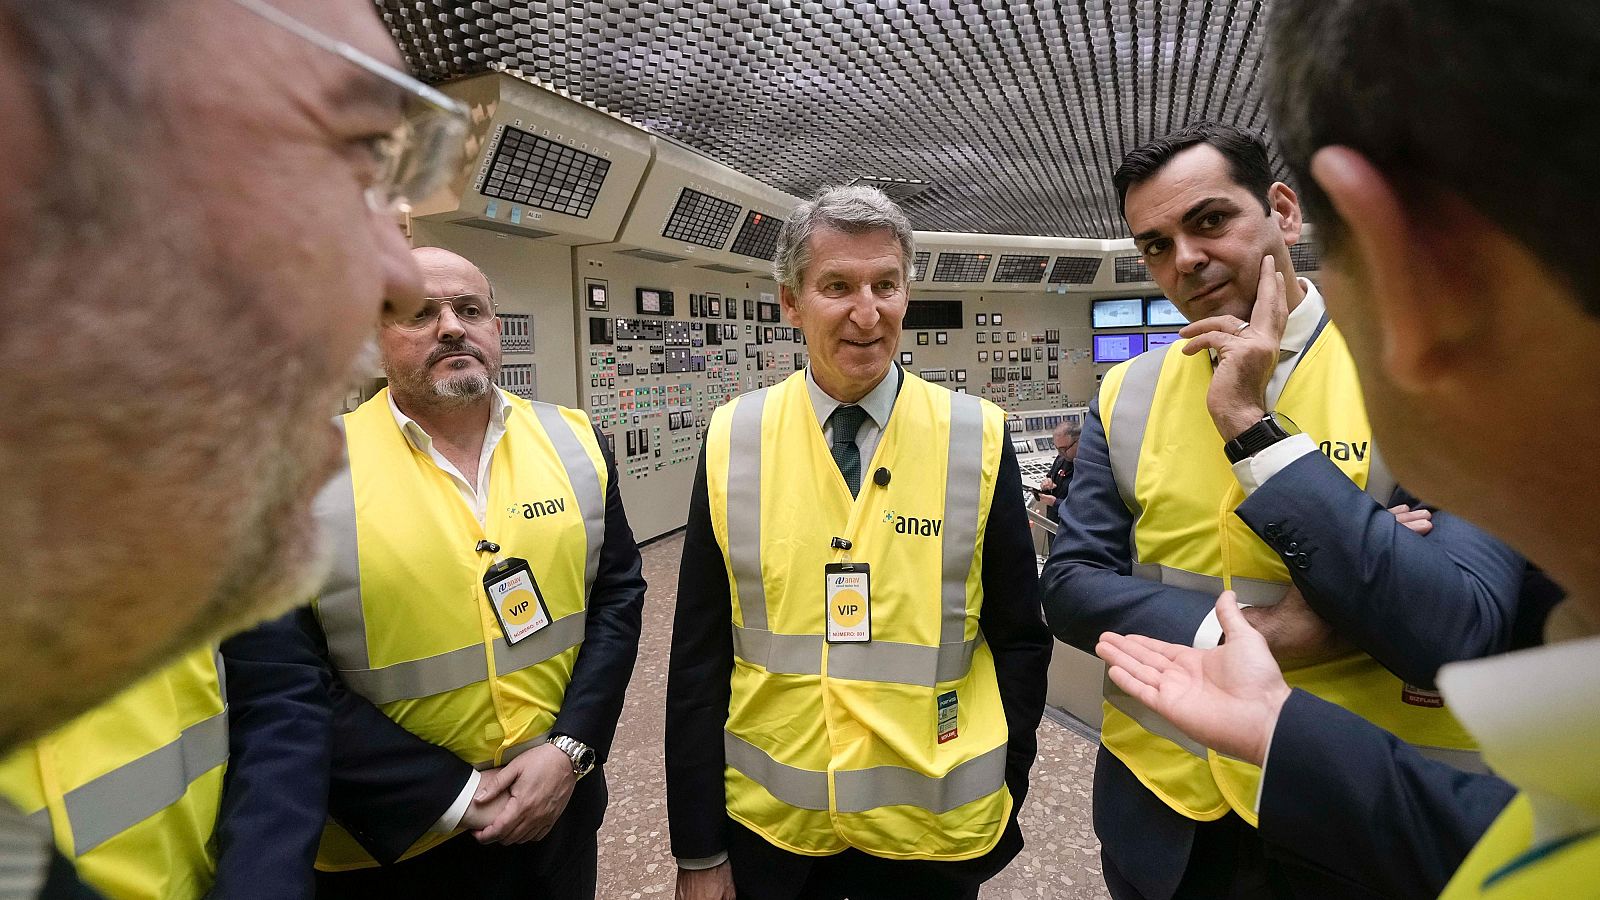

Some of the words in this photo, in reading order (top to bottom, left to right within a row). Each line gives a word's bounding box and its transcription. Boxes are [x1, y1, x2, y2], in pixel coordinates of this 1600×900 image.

[1319, 440, 1368, 461] nav
[522, 497, 565, 519] anav
[895, 515, 942, 537] anav
[507, 576, 522, 588] anav
[509, 600, 529, 617] VIP
[837, 604, 858, 616] VIP
